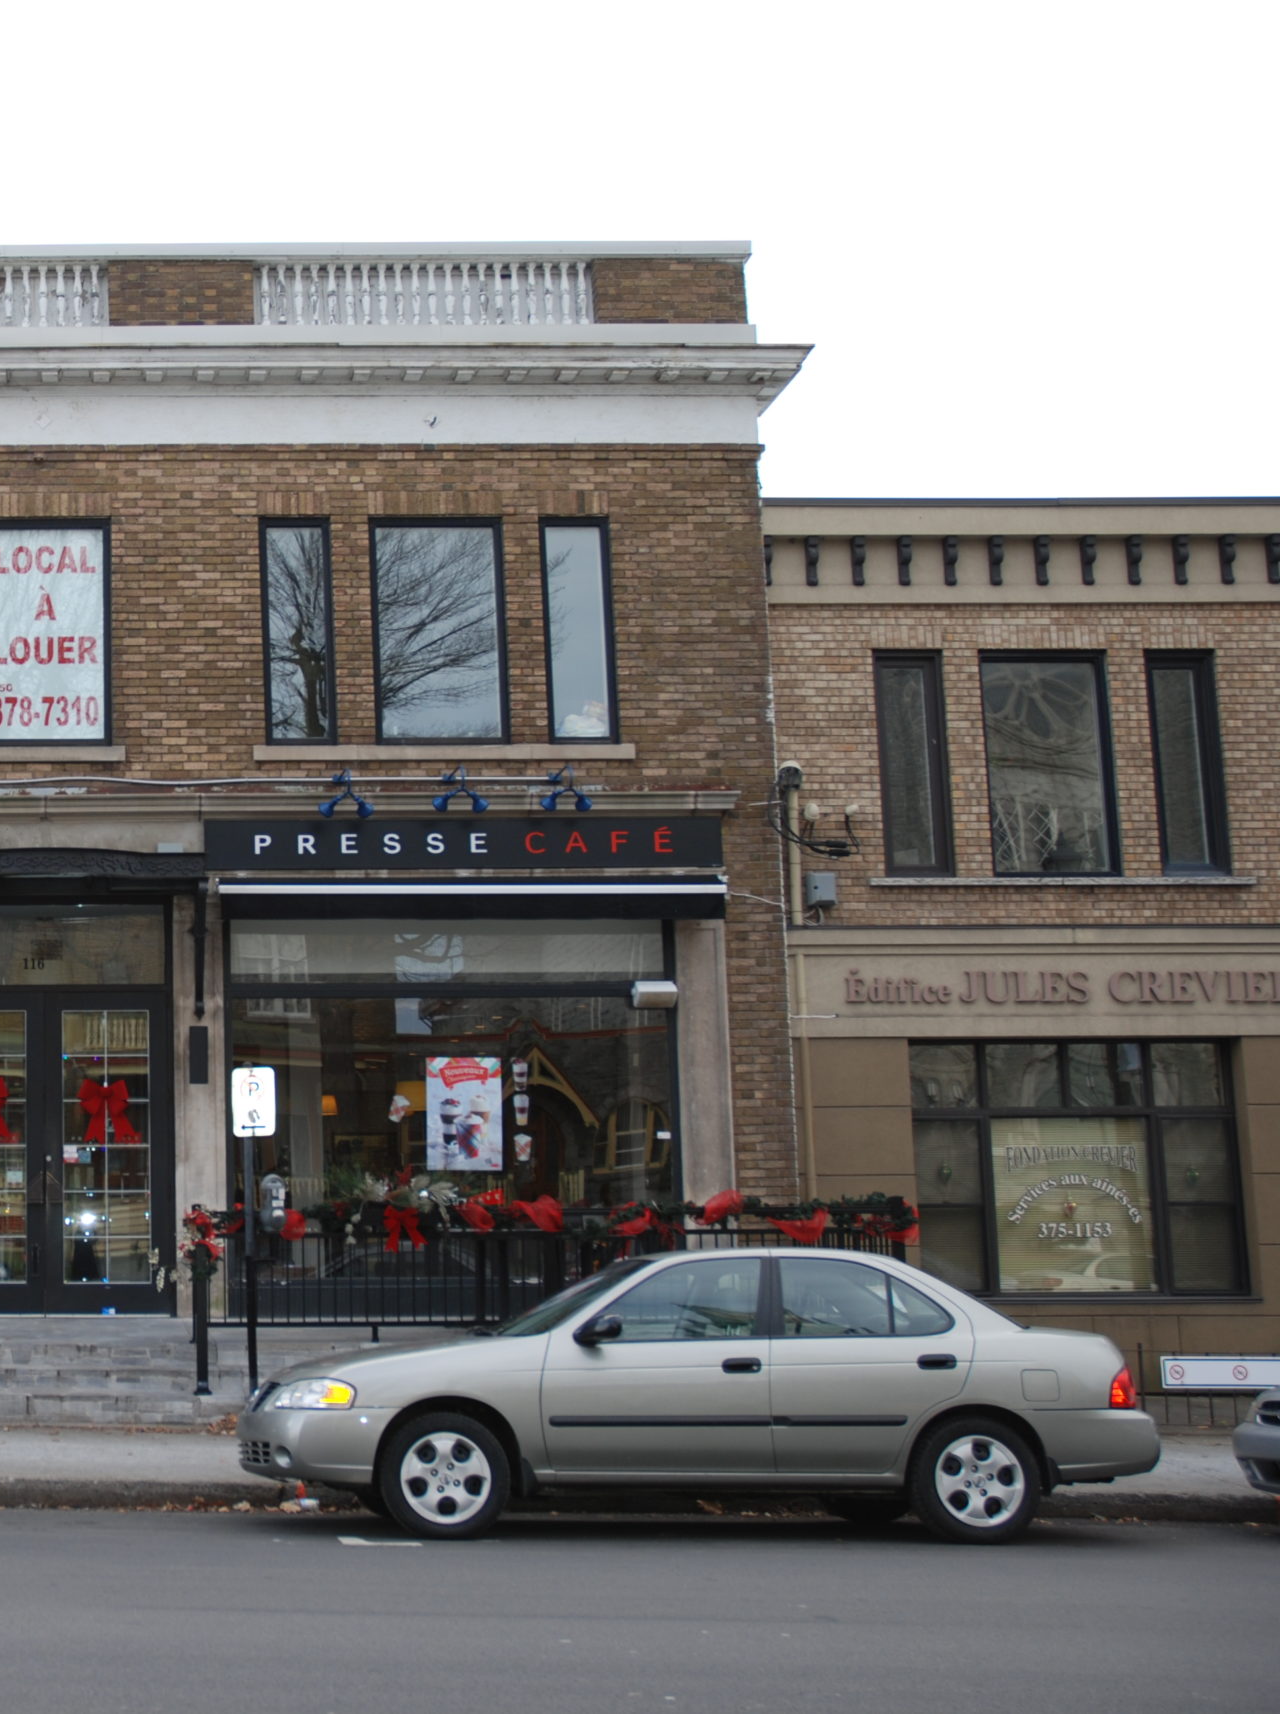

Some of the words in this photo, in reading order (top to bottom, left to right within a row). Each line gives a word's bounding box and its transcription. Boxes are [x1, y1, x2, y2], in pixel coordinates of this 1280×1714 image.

[34, 584, 57, 621] À
[253, 832, 489, 855] PRESSE
[524, 826, 674, 855] CAFÉ
[22, 957, 45, 971] 116
[844, 968, 952, 1005] Édifice
[958, 970, 1090, 1005] JULES
[1005, 1145, 1079, 1173] FONDATION
[1081, 1145, 1138, 1173] CREVIER
[1007, 1177, 1057, 1225] Services
[1061, 1173, 1088, 1186] aux
[1092, 1177, 1143, 1225] aînés-es
[1038, 1222, 1112, 1239] 375-1153
